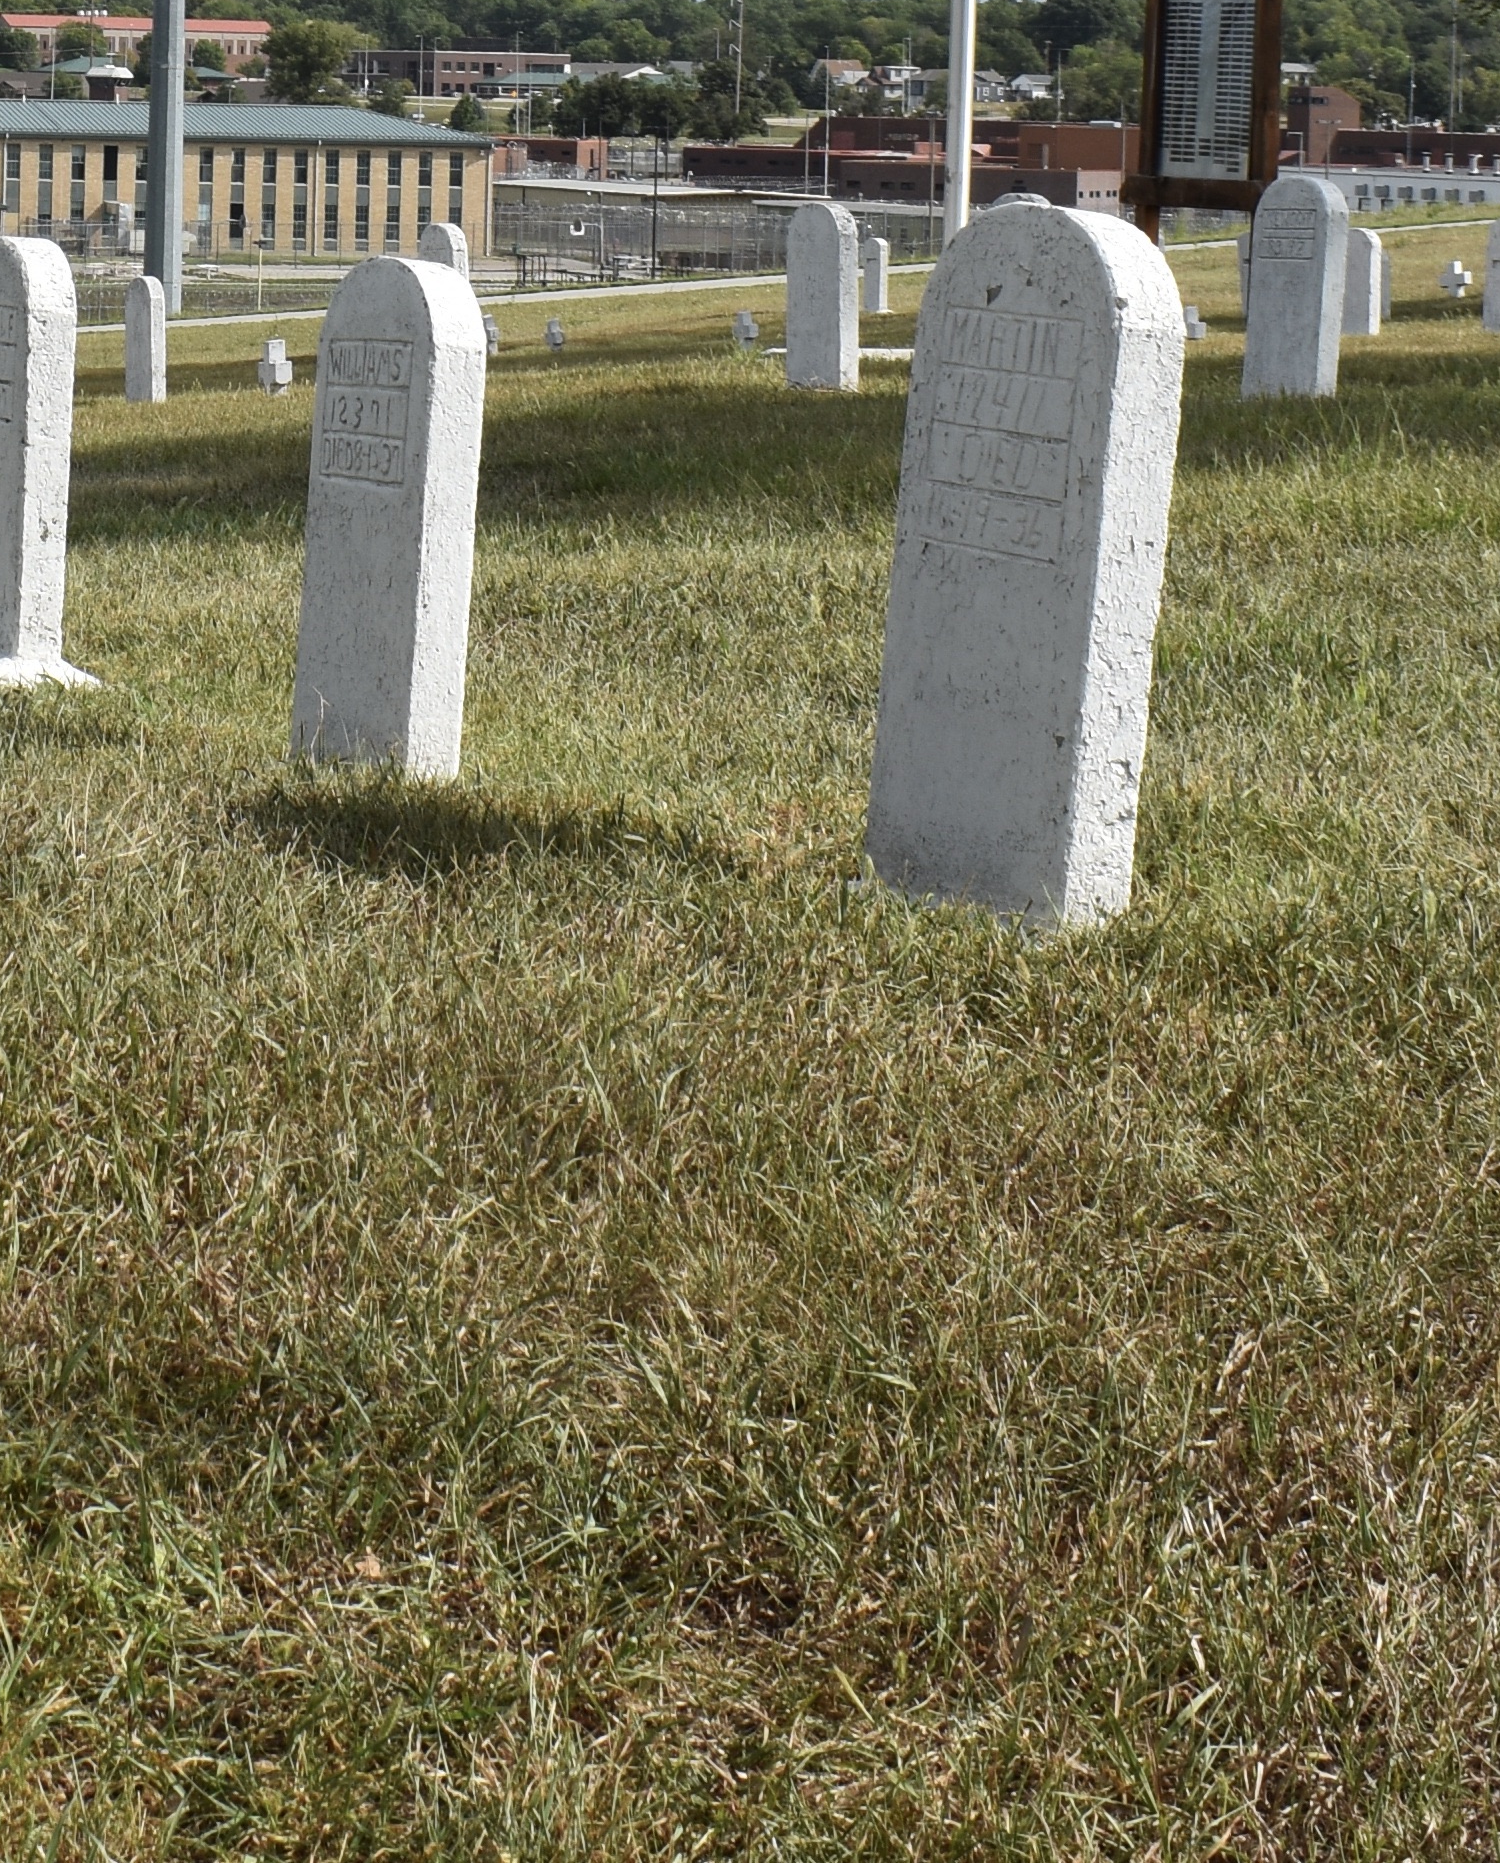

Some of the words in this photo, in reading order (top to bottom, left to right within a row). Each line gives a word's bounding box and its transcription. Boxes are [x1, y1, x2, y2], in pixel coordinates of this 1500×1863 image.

[328, 343, 404, 386] WILLIAMS
[947, 312, 1062, 375] MARTIN
[330, 394, 392, 437] 12371
[958, 432, 1040, 491] DIED
